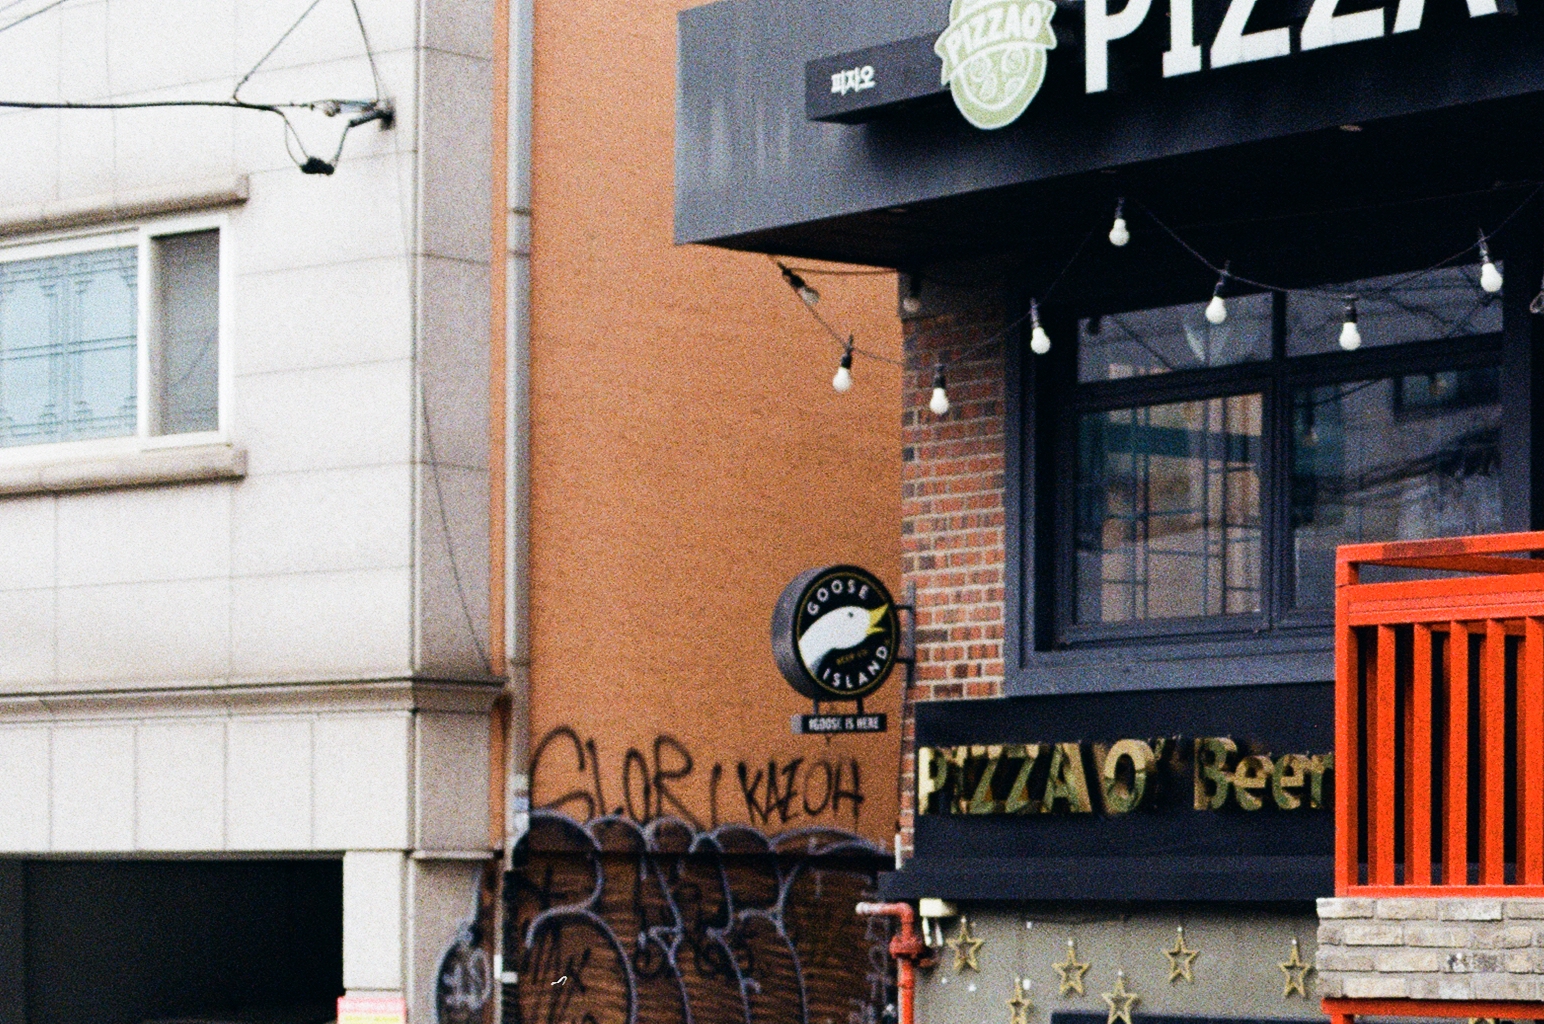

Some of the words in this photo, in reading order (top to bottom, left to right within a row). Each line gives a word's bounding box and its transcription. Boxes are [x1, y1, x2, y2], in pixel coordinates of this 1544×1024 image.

[1086, 0, 1499, 94] PIZ
[831, 65, 876, 96] 피자오
[806, 579, 871, 616] GOOSE
[822, 645, 888, 689] ISLAND
[856, 717, 879, 730] HERE
[1194, 735, 1335, 811] Beer
